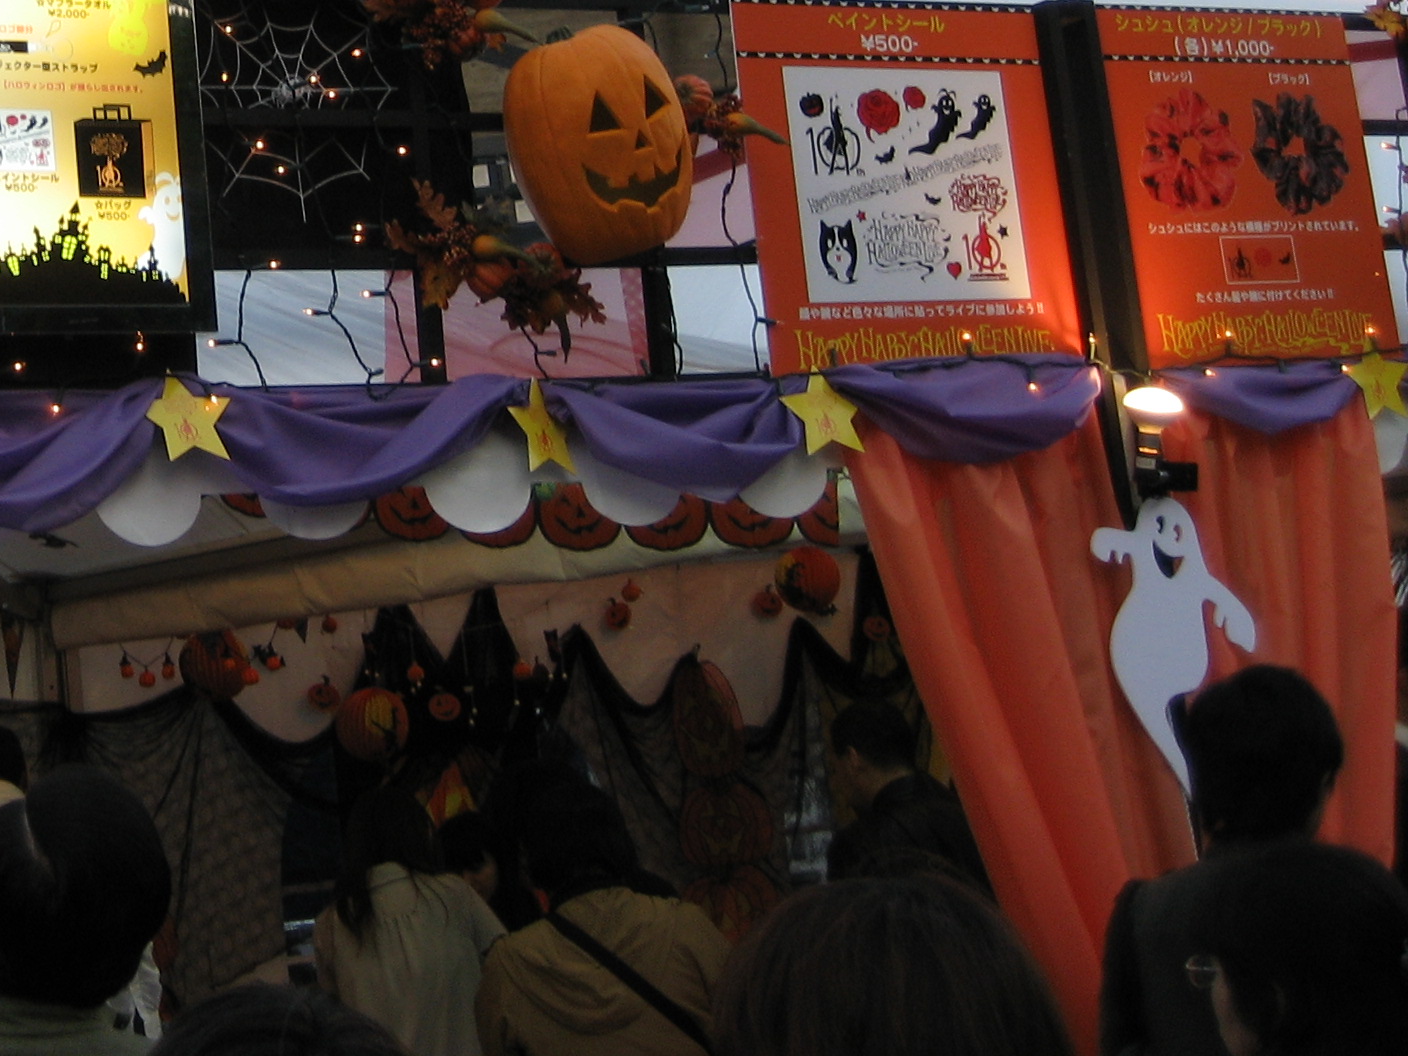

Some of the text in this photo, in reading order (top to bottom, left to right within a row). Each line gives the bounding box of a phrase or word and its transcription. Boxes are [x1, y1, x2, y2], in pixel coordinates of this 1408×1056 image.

[47, 0, 111, 9] マフラータオル
[827, 12, 945, 34] ペイントシール
[1114, 9, 1323, 38] シュシュ(オレンジ/ブラック)
